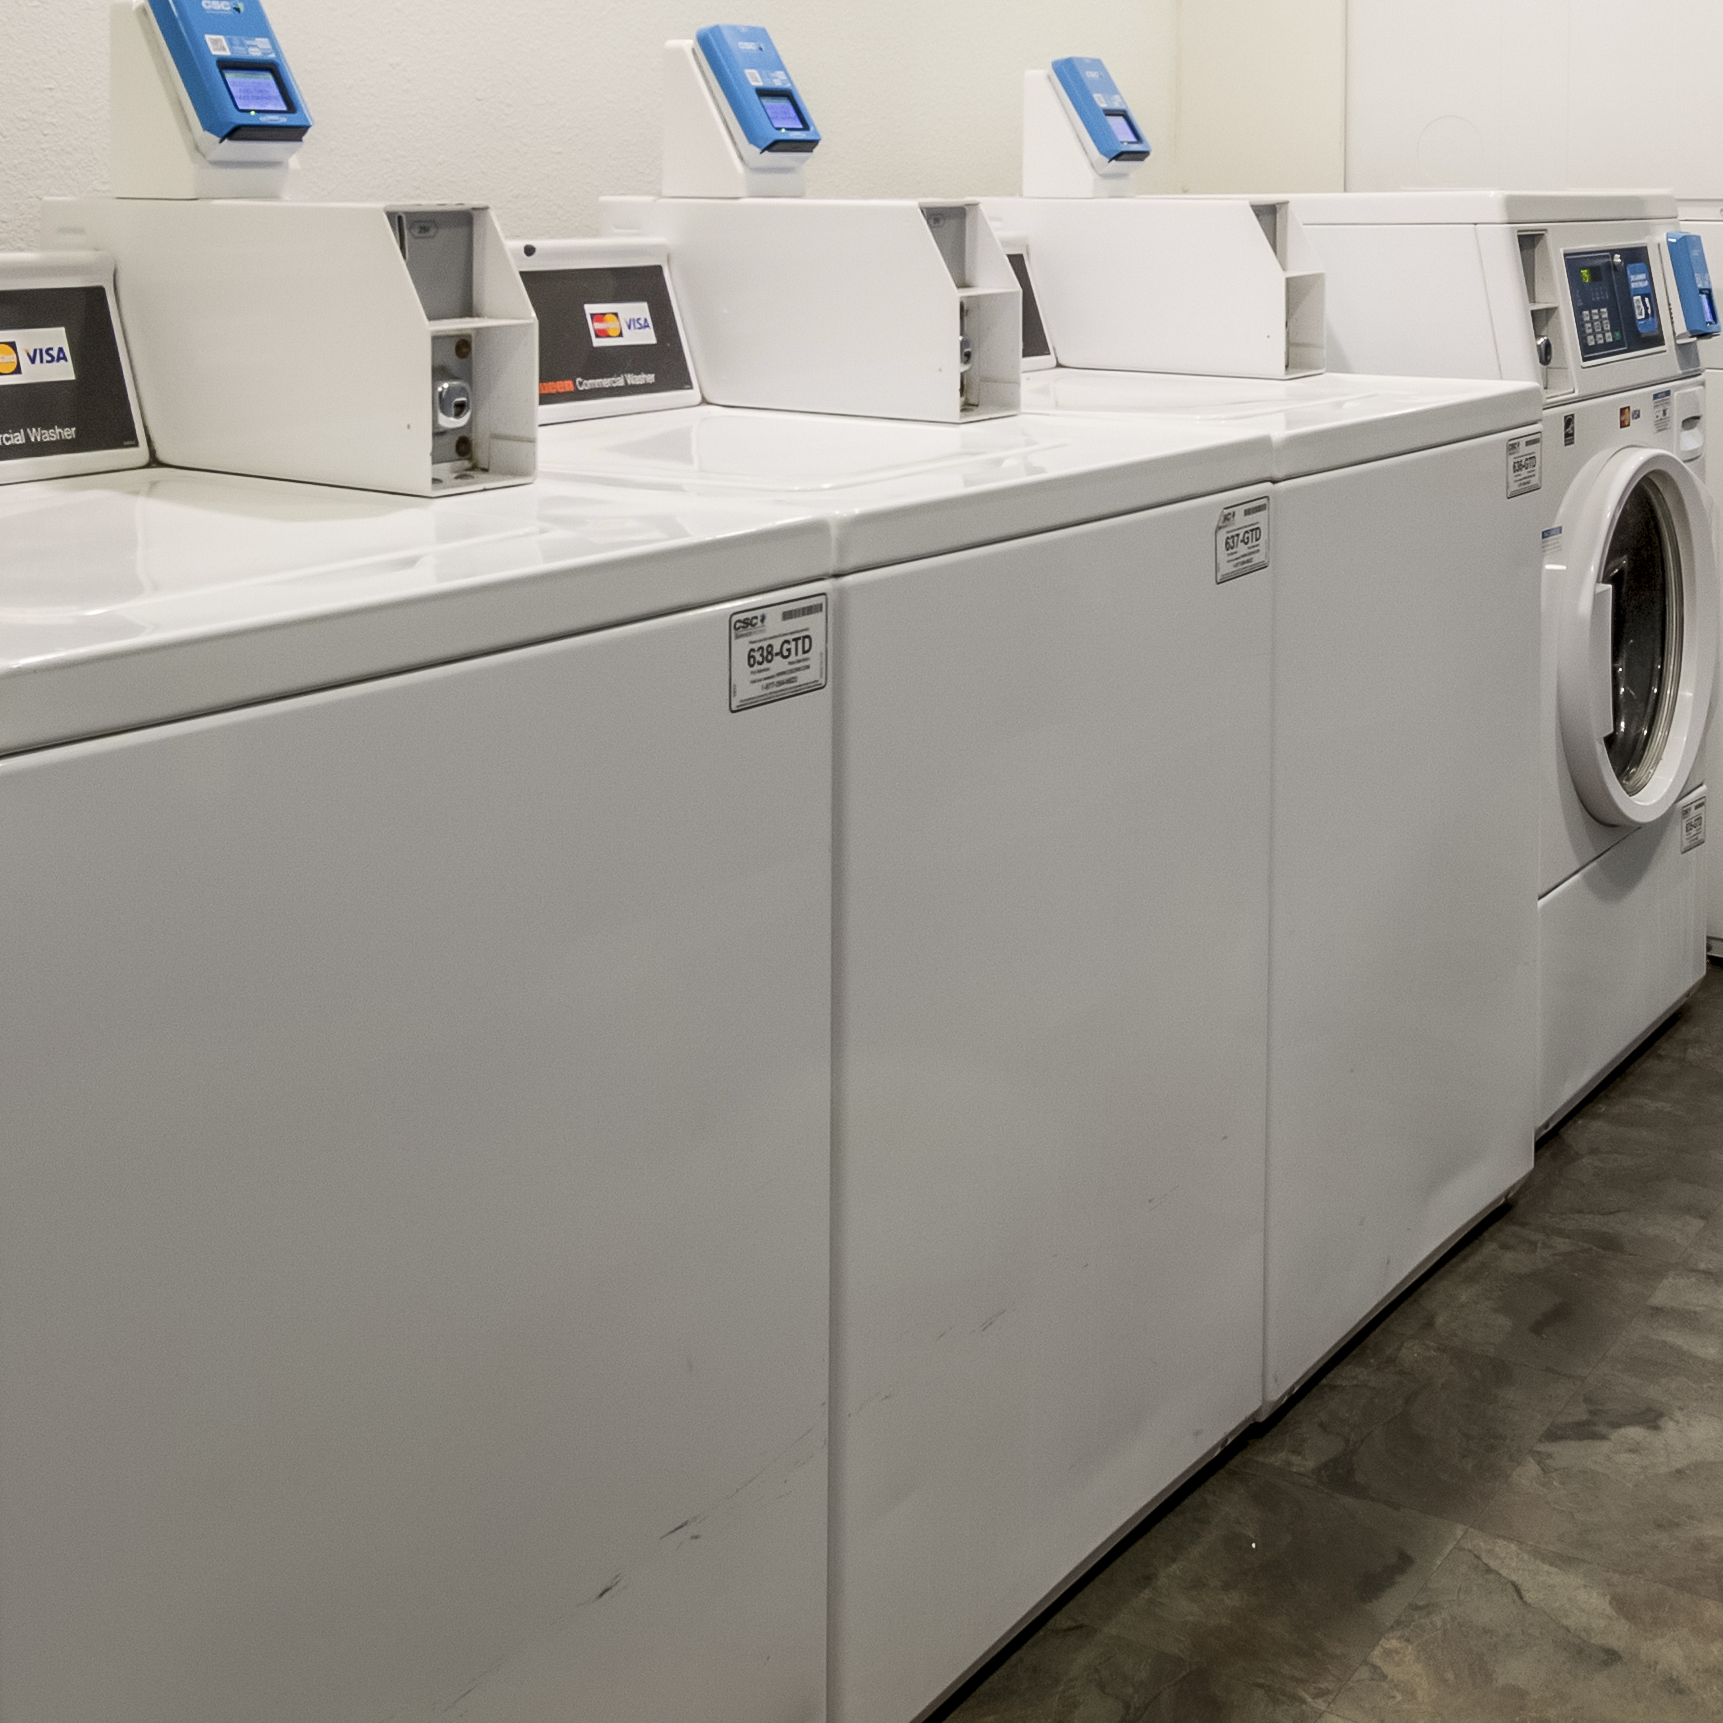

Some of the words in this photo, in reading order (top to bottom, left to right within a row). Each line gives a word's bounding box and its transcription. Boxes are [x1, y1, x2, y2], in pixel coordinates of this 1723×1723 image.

[202, 0, 231, 10] CSC
[625, 317, 651, 331] VISA
[24, 346, 68, 365] VISA
[539, 379, 575, 394] ueen
[576, 374, 624, 391] Commercial
[624, 373, 656, 386] Washer
[27, 425, 77, 443] Washer
[1225, 526, 1262, 551] 637-GTD
[733, 615, 758, 631] CSC
[747, 634, 813, 668] 638-GTD
